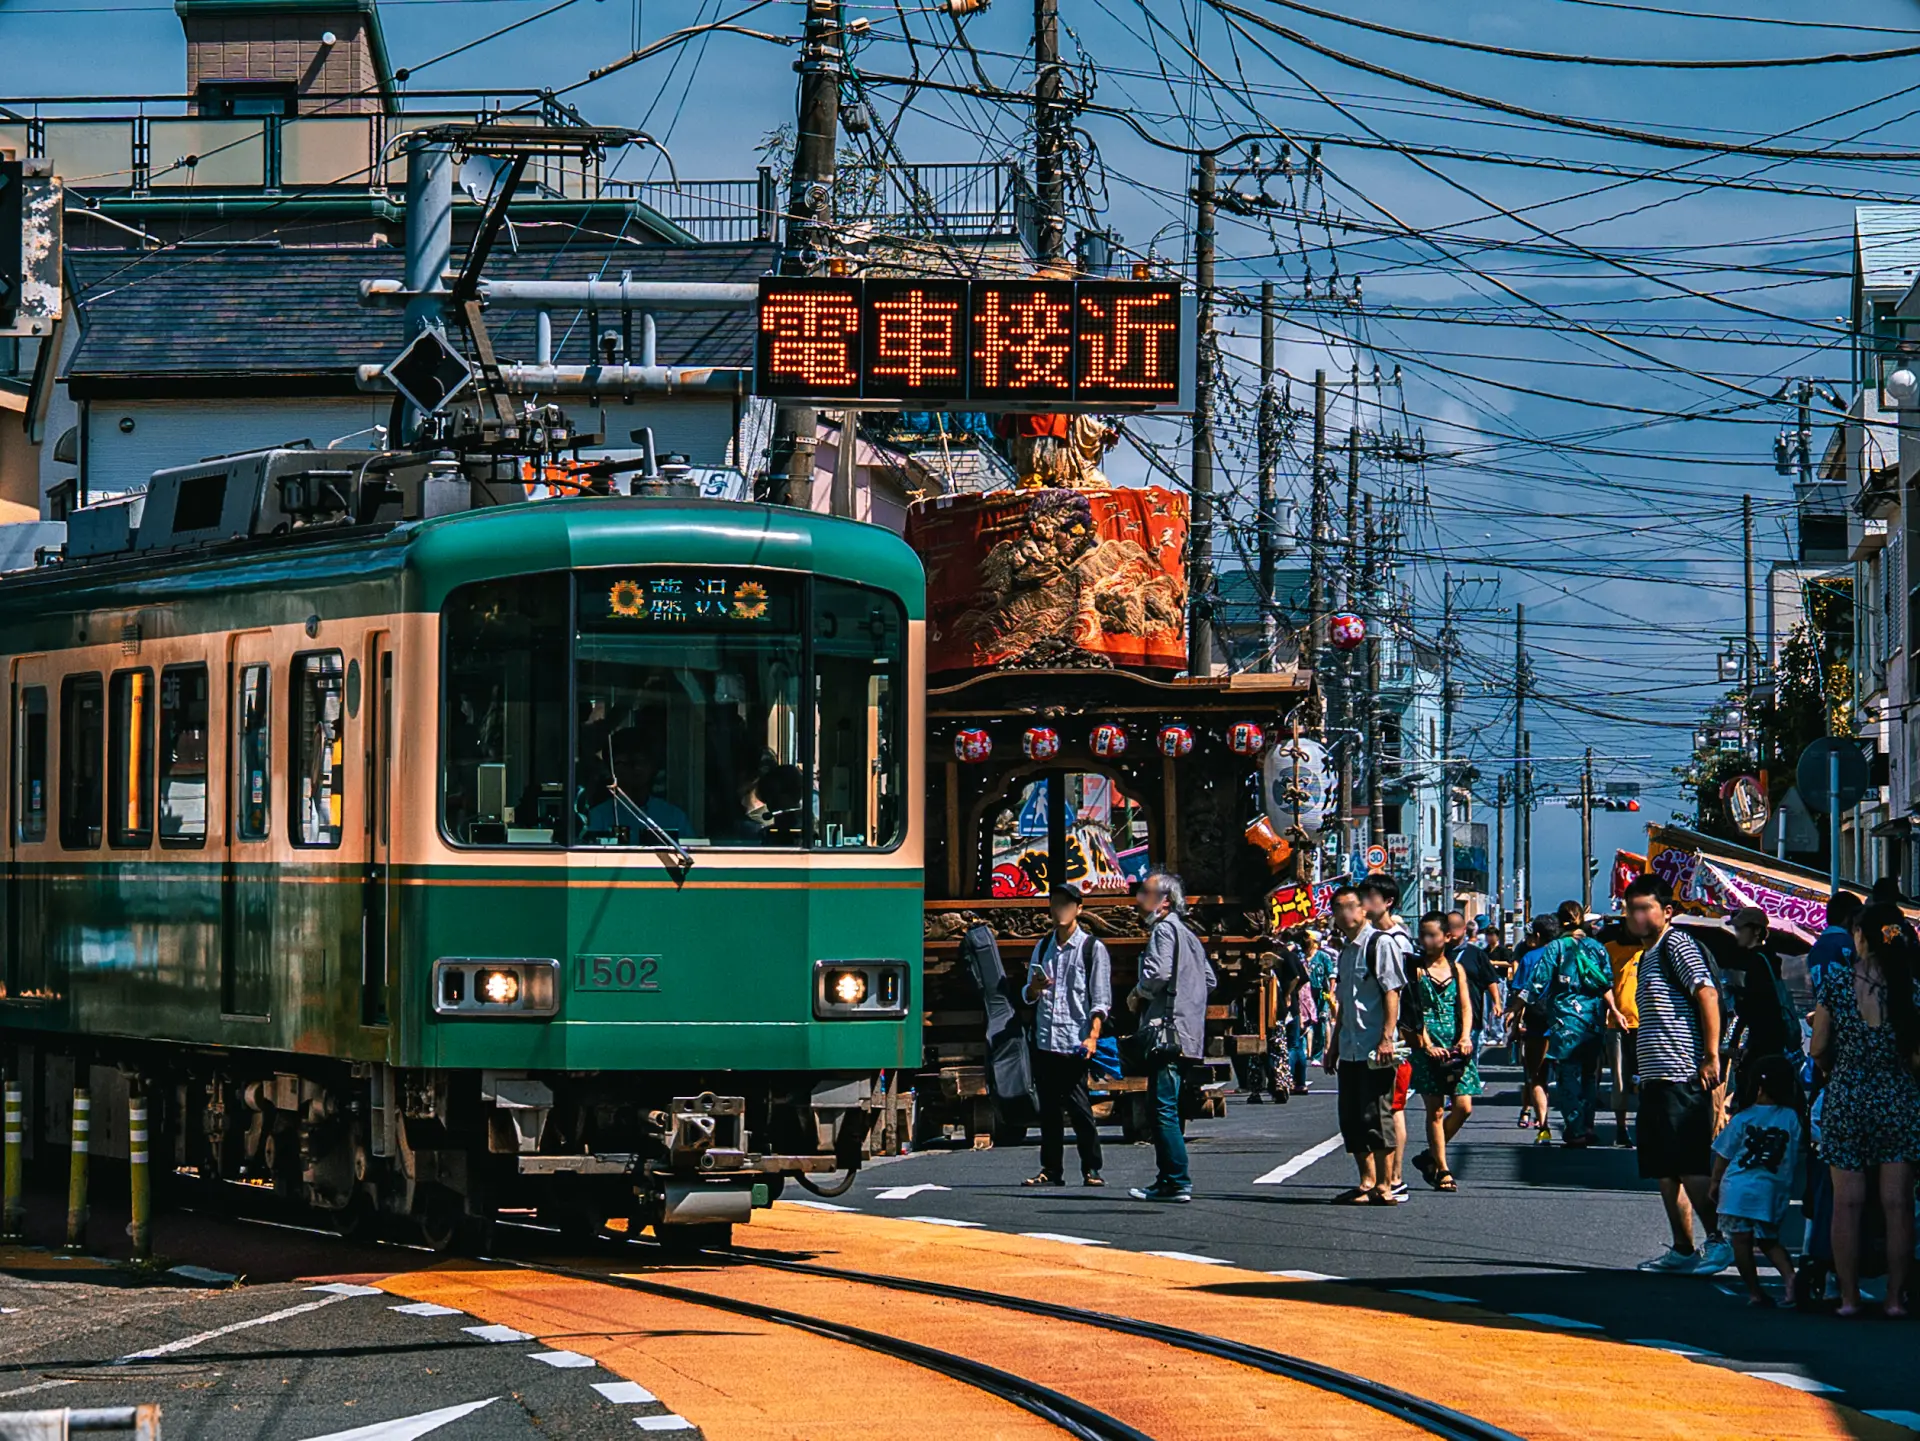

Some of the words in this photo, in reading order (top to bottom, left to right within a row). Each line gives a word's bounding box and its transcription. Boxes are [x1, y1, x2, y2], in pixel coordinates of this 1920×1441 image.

[761, 290, 1176, 388] 電車接近
[1370, 851, 1383, 863] 30
[578, 957, 659, 988] 1502
